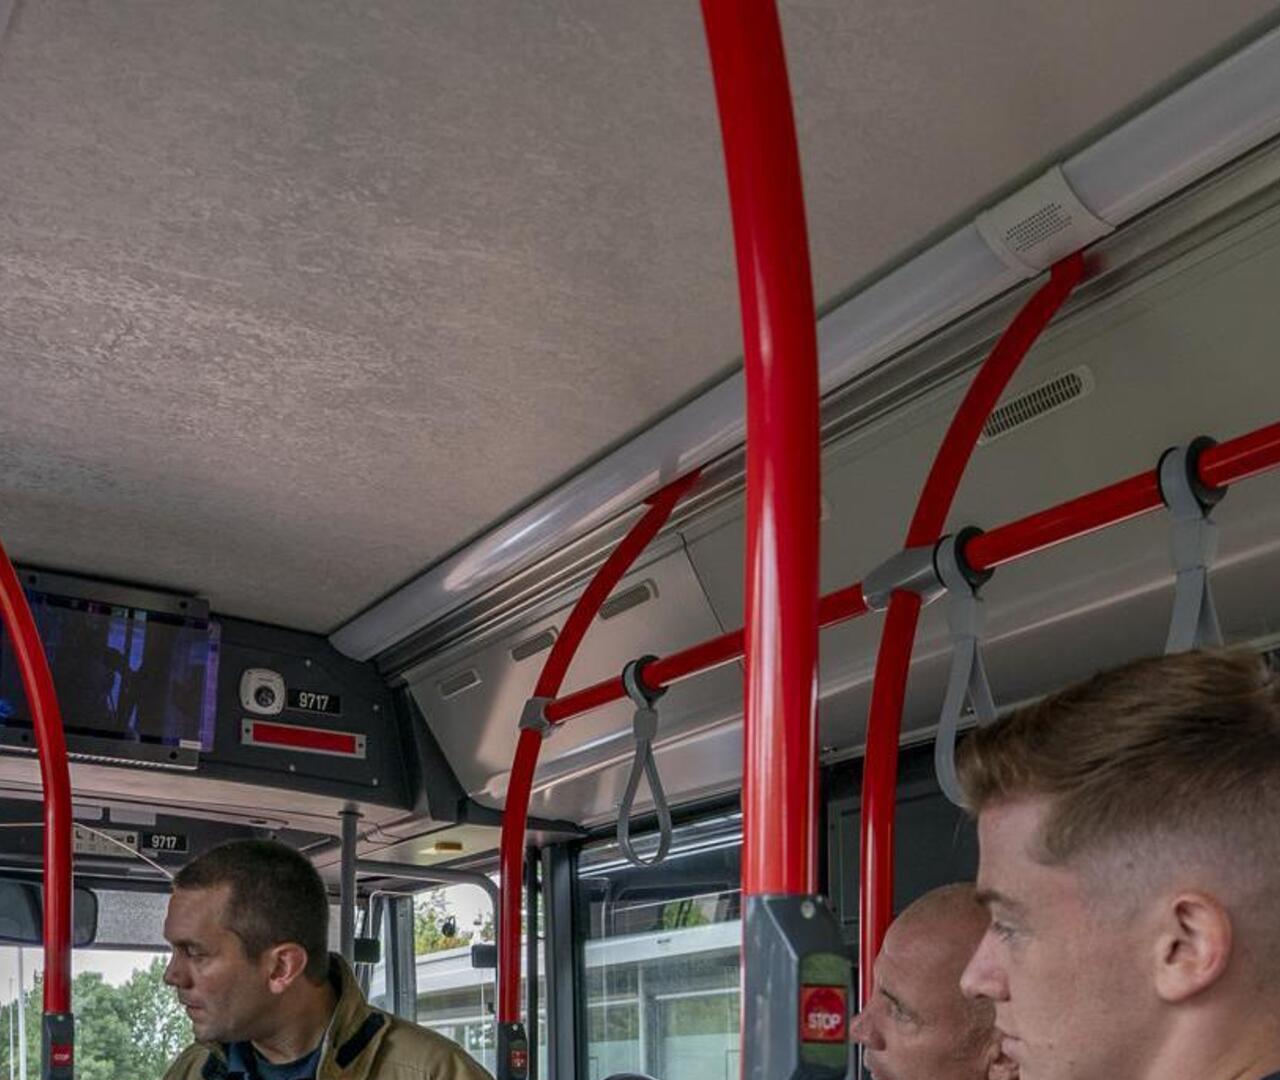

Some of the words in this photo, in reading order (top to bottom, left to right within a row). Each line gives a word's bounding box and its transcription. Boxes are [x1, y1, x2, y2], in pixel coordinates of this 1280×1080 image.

[299, 692, 330, 711] 9717
[151, 834, 177, 849] 9717
[807, 1012, 842, 1031] STOP
